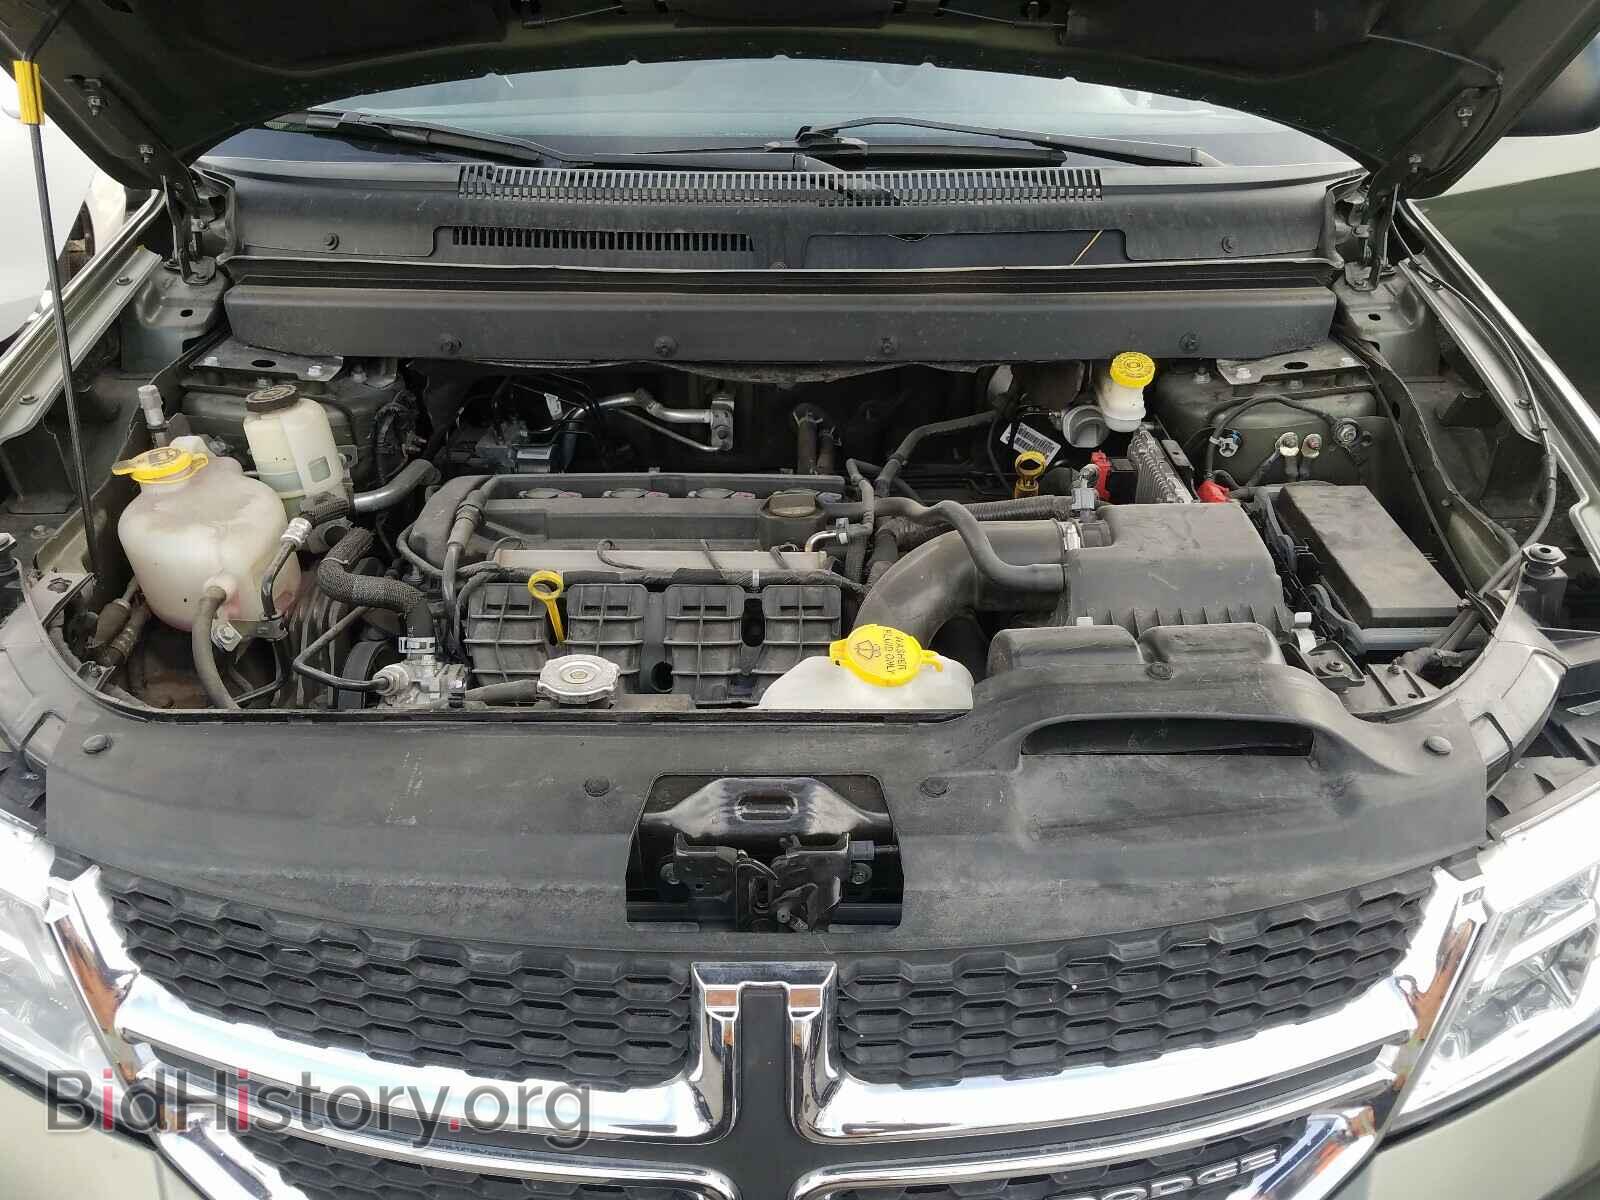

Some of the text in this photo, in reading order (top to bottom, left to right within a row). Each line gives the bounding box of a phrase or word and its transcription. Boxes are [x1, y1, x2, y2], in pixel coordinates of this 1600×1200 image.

[883, 629, 896, 674] FLUID ONLY
[1072, 1147, 1280, 1200] ODGE
